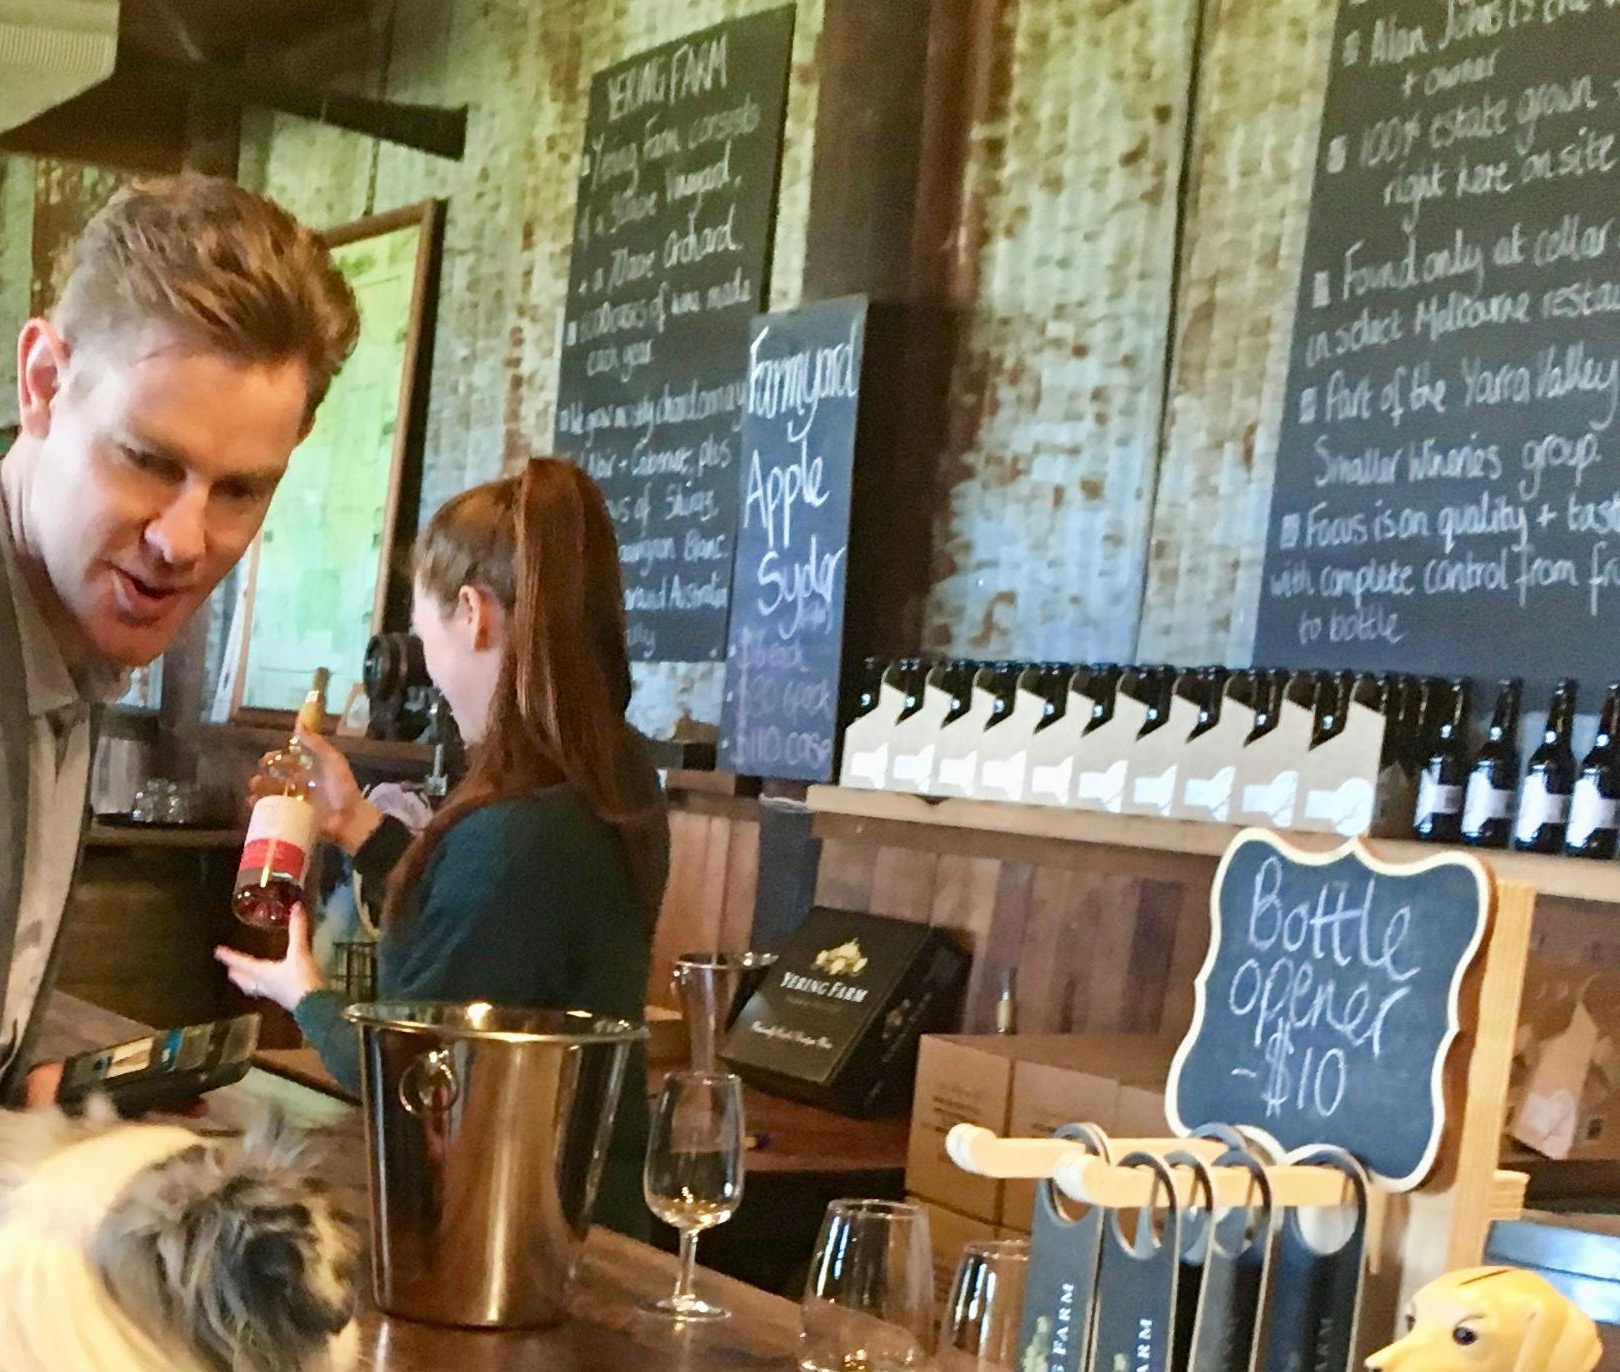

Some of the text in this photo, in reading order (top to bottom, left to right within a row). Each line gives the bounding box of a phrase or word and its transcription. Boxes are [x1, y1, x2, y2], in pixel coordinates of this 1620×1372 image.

[1343, 214, 1615, 300] Found only at cellar
[1335, 306, 1403, 354] select
[1415, 289, 1531, 341] Melbourne
[1326, 368, 1374, 423] Part
[1381, 364, 1407, 428] of
[1409, 359, 1447, 414] the
[1462, 356, 1530, 407] Yarra
[743, 436, 829, 549] Apple
[1314, 434, 1404, 488] Smaller
[1304, 501, 1369, 548] Focus
[1373, 498, 1394, 542] is
[1399, 508, 1428, 539] on
[1437, 490, 1528, 555] quality
[1270, 560, 1314, 598] with
[1319, 557, 1416, 610] complete
[1424, 548, 1508, 595] control
[1514, 543, 1579, 607] from
[1298, 603, 1405, 645] to bottle
[1249, 856, 1421, 981] Bottle
[780, 971, 869, 1002] YERING FARM
[1229, 956, 1412, 1059] opener
[1052, 1283, 1074, 1355] FARM
